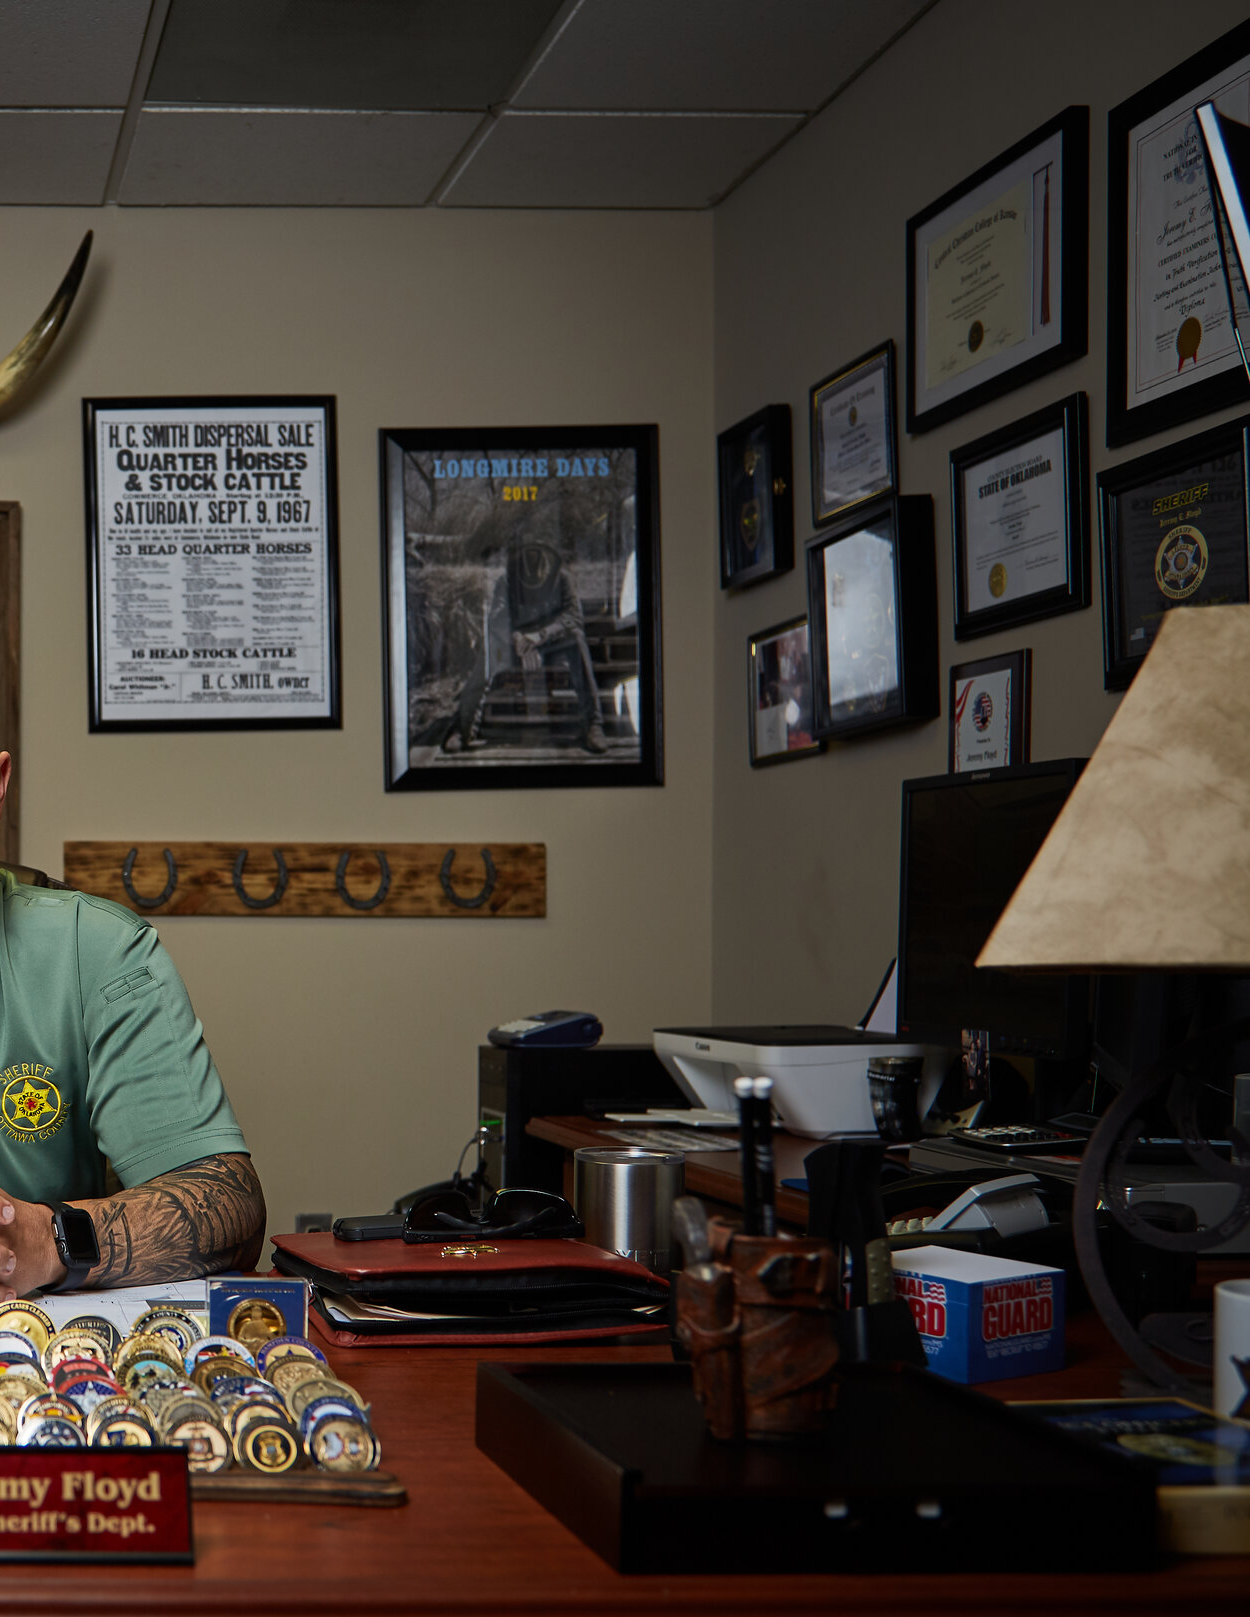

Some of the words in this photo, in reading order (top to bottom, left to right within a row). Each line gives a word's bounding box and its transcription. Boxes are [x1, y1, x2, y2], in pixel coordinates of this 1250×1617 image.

[109, 426, 121, 448] H.
[126, 426, 139, 448] C.
[143, 426, 188, 448] SMITH
[194, 425, 272, 448] DISPERSAL
[278, 424, 314, 447] SALE
[117, 449, 217, 471] QUARTER
[226, 448, 307, 471] HORSES
[434, 459, 548, 479] LONGMIRE
[556, 458, 609, 478] DAYS
[125, 473, 142, 491] &
[150, 473, 217, 491] STOCK
[224, 472, 301, 490] CATTLE
[979, 481, 999, 499] STATE
[1000, 477, 1010, 490] OF
[1011, 459, 1052, 486] OKLAHOMA
[503, 486, 538, 501] 2017
[1152, 483, 1209, 516] SHERIFF
[114, 501, 202, 525] SATURDAY,
[208, 501, 251, 524] SEPT.
[257, 501, 271, 525] 9,
[277, 501, 311, 524] 1967
[116, 545, 132, 555] 33
[138, 544, 177, 555] HEAD
[183, 544, 251, 555] QUARTER
[256, 543, 312, 554] HORSES
[131, 649, 145, 659] 16
[150, 648, 188, 659] HEAD
[192, 648, 238, 659] STOCK
[243, 648, 297, 658] CATTLE
[202, 674, 214, 689] H.
[217, 674, 228, 689] C.
[18, 1092, 35, 1105] STATE
[19, 1102, 45, 1117] OKLAHOMA
[39, 1102, 70, 1140] COUNTY
[983, 1280, 1037, 1304] NATIONAL
[983, 1296, 1053, 1341] GUARD
[61, 1471, 162, 1508] Floyd
[87, 1512, 156, 1538] Dept.
